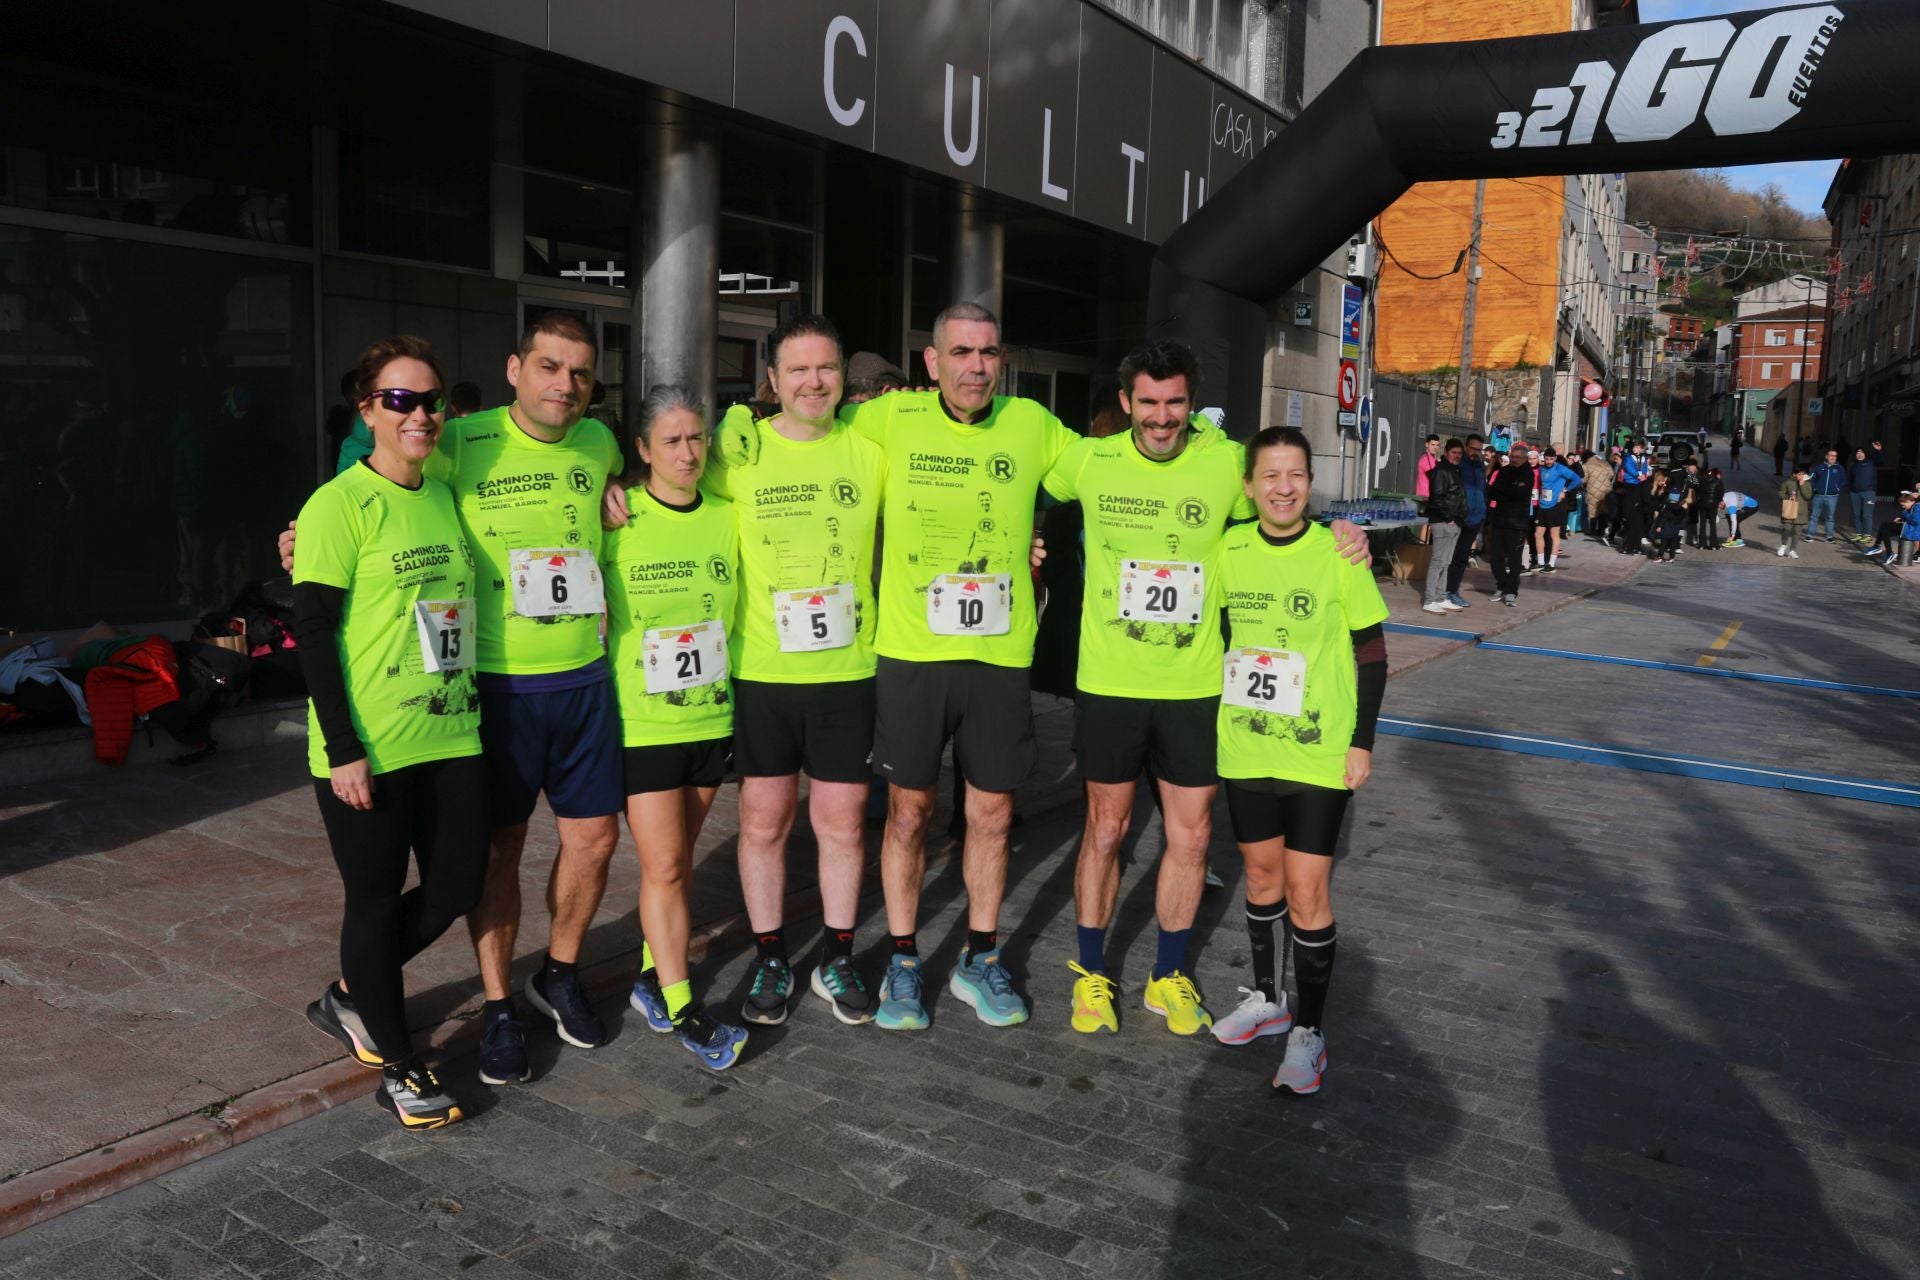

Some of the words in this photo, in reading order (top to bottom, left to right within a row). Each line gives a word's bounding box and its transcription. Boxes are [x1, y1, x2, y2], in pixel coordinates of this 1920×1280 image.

[1787, 13, 1842, 109] EVENTOS
[1214, 103, 1253, 160] CASA
[909, 462, 970, 475] SALVADOR
[910, 452, 954, 464] CAMINO
[956, 457, 978, 466] DEL
[994, 459, 1010, 480] R
[476, 474, 532, 490] CAMINO
[534, 472, 560, 482] DEL
[478, 482, 552, 499] SALVADOR
[574, 472, 590, 491] R
[754, 484, 799, 497] CAMINO
[801, 484, 823, 492] DEL
[755, 494, 816, 506] SALVADOR
[838, 484, 856, 504] R
[1098, 494, 1144, 506] CAMINO
[1146, 499, 1168, 509] DEL
[1098, 503, 1160, 517] SALVADOR
[1186, 504, 1202, 524] R
[392, 545, 436, 563] CAMINO
[436, 544, 454, 553] DEL
[394, 555, 450, 575] SALVADOR
[630, 561, 676, 573] CAMINO
[678, 560, 700, 568] DEL
[714, 561, 730, 580] R
[630, 570, 694, 582] SALVADOR
[552, 575, 568, 603] 6
[1257, 592, 1277, 602] DEL
[1146, 586, 1178, 612] 20
[1228, 601, 1268, 610] ALVADOR
[1293, 595, 1310, 616] R
[958, 599, 984, 624] 10
[811, 612, 828, 638] 5
[440, 628, 461, 659] 13
[676, 649, 702, 678] 21
[1247, 672, 1278, 700] 25
